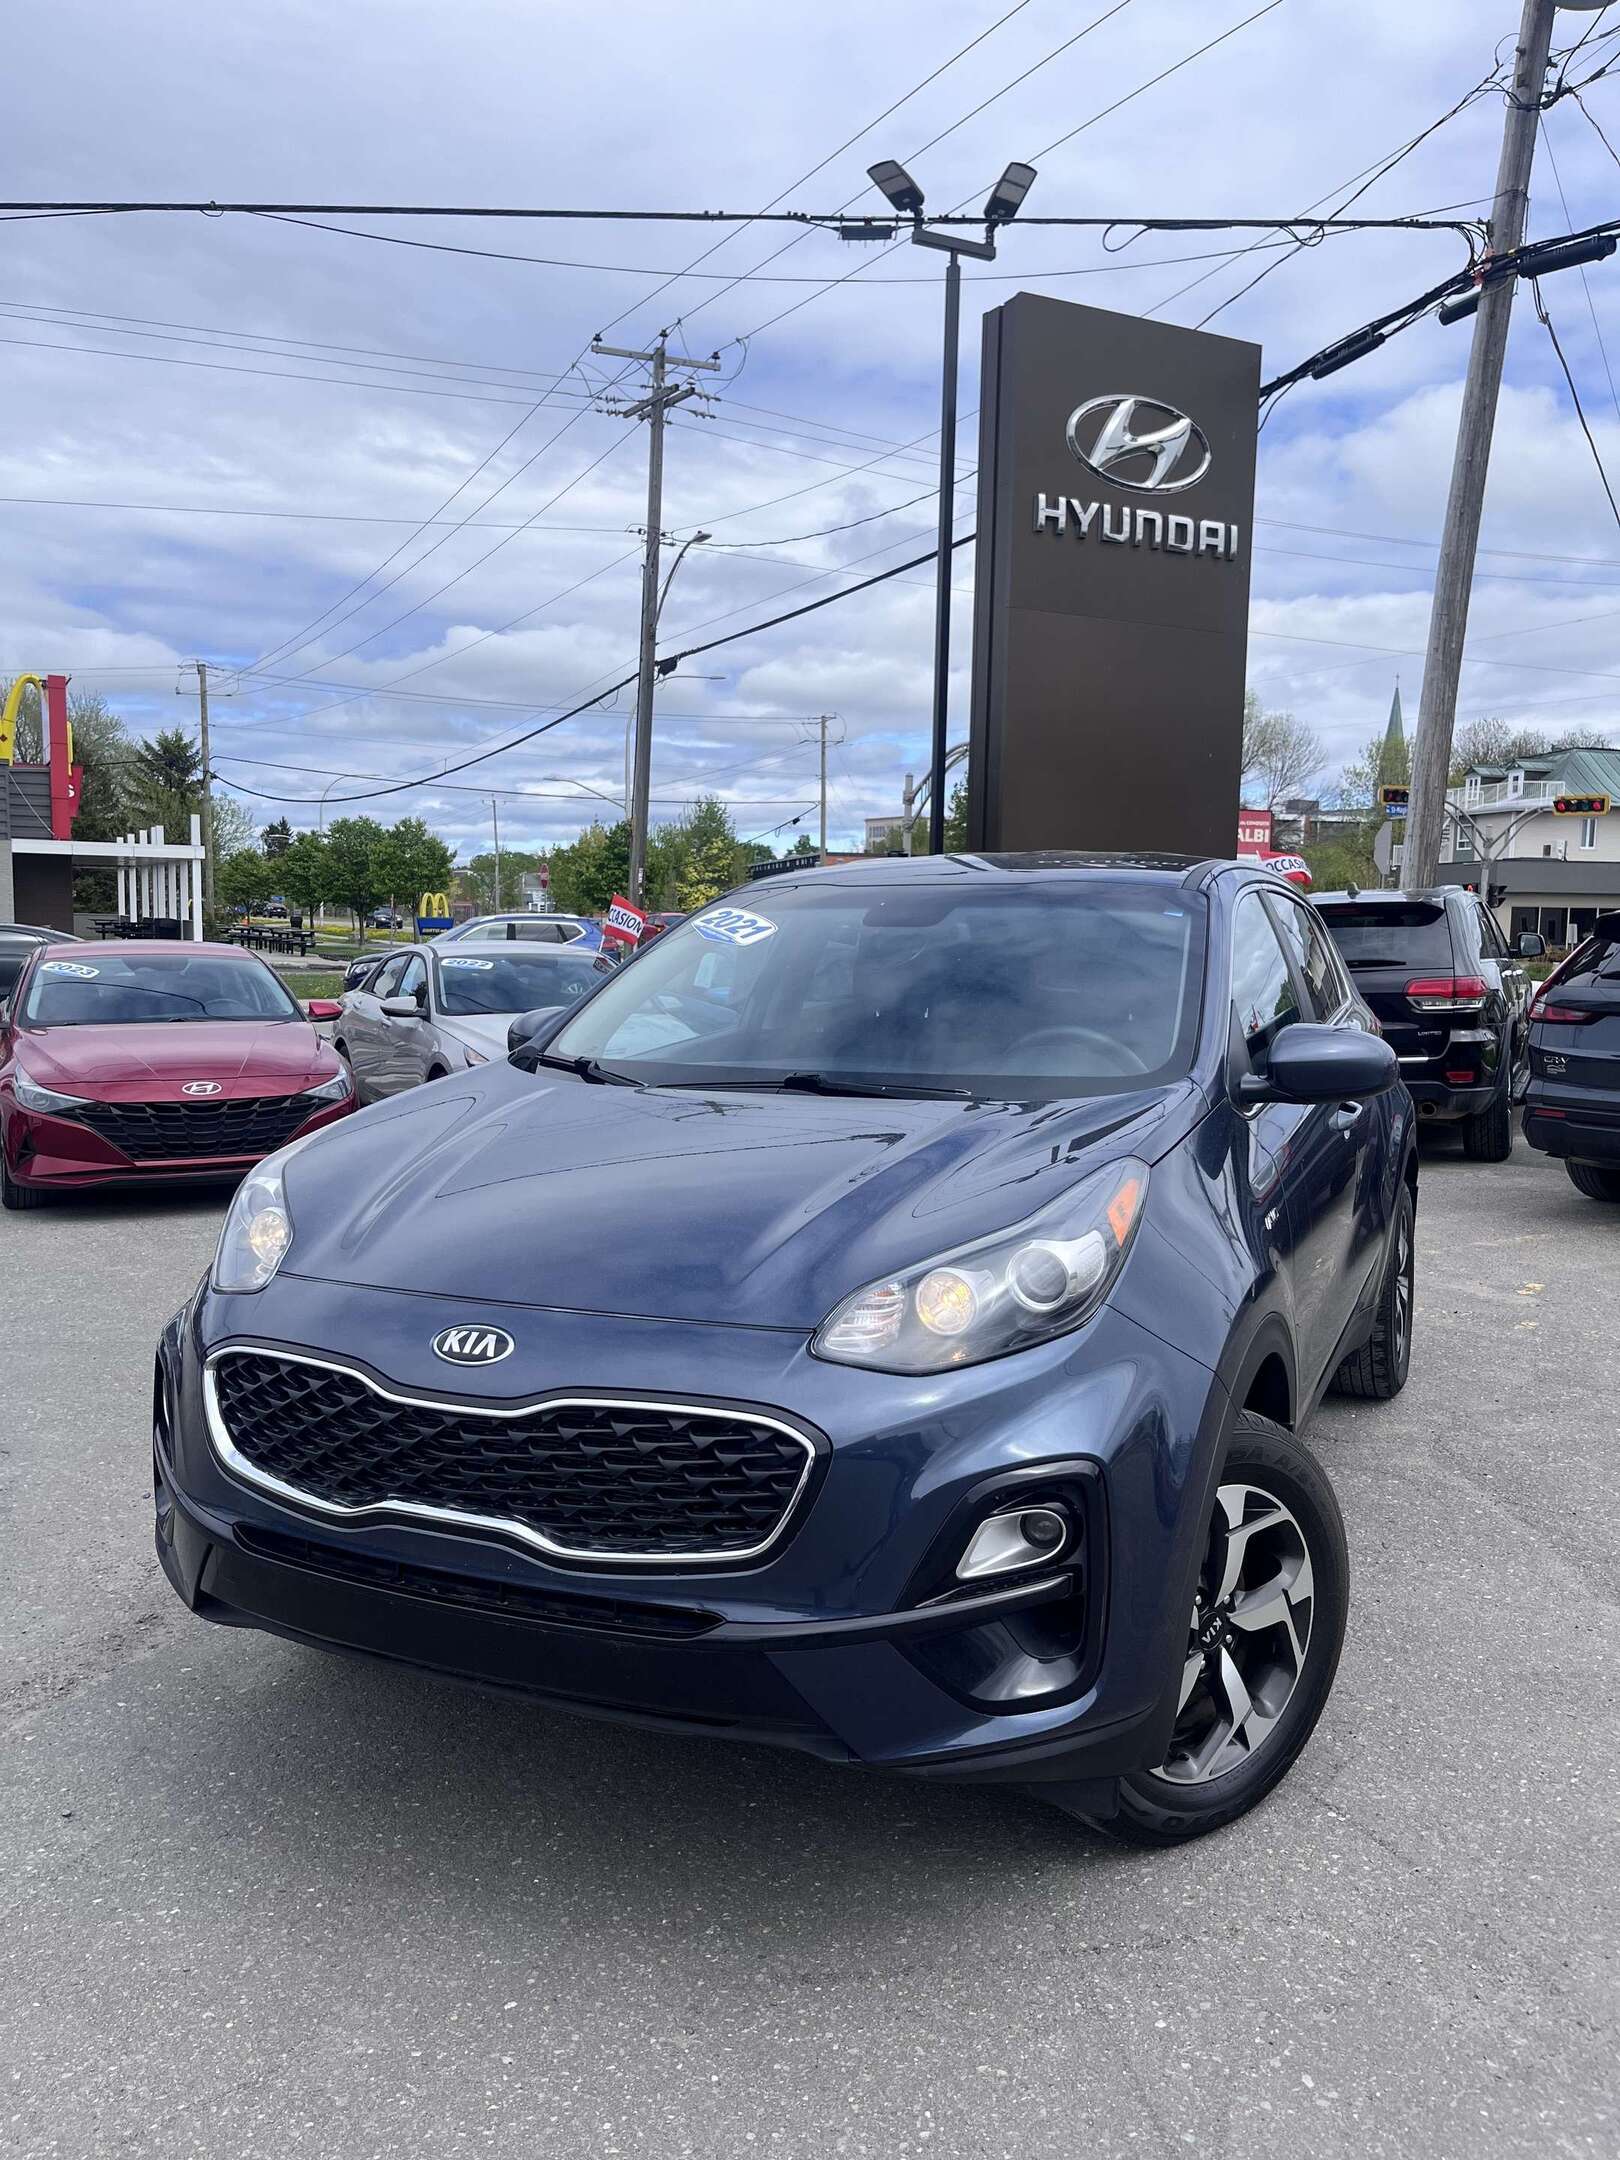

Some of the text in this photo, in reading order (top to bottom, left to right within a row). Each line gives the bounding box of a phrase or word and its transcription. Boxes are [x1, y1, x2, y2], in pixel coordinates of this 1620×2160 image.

[1035, 493, 1238, 559] HYUNDAI
[700, 910, 772, 939] 2021
[442, 1330, 497, 1357] KIA
[1201, 1617, 1222, 1643] KIA
